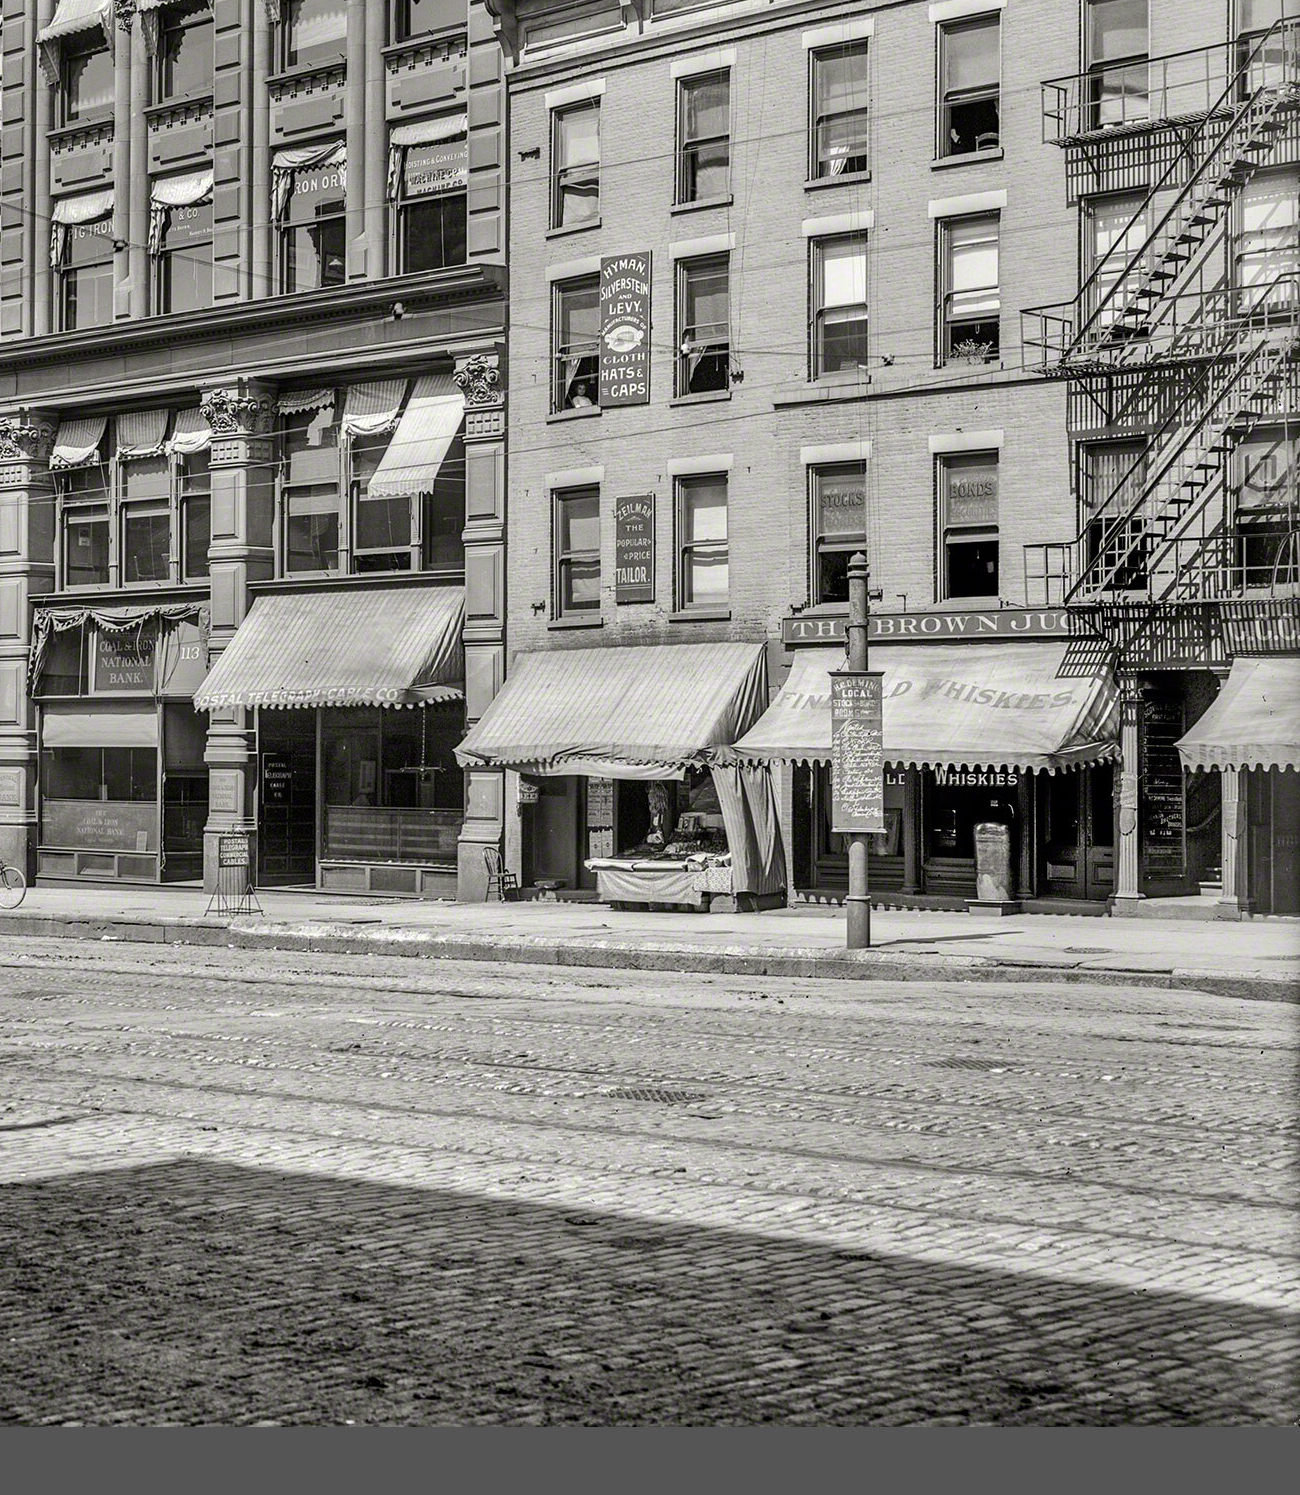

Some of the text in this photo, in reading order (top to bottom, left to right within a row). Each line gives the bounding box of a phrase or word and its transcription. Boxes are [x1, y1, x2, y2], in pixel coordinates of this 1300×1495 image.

[601, 278, 648, 301] SILVERSTEIN
[608, 300, 643, 315] LEVY.
[601, 316, 647, 337] MANUFACTURERS OF
[603, 352, 645, 364] CLOTH
[601, 367, 643, 381] HATS &
[611, 382, 646, 397] CAPS
[949, 481, 995, 499] BONDS
[820, 491, 864, 508] STOCKS
[617, 503, 652, 521] ZEILMAN
[617, 538, 648, 547] POPULAR
[628, 551, 651, 560] PRICE
[616, 566, 651, 583] TAILOR.
[873, 614, 1003, 635] BROWN
[181, 646, 200, 660] 113
[101, 656, 152, 668] NATIONAL
[841, 689, 873, 698] LOCAL
[194, 694, 243, 711] POSTAL
[935, 766, 1019, 786] WHISKIES
[221, 844, 249, 852] TELEGRAPH
